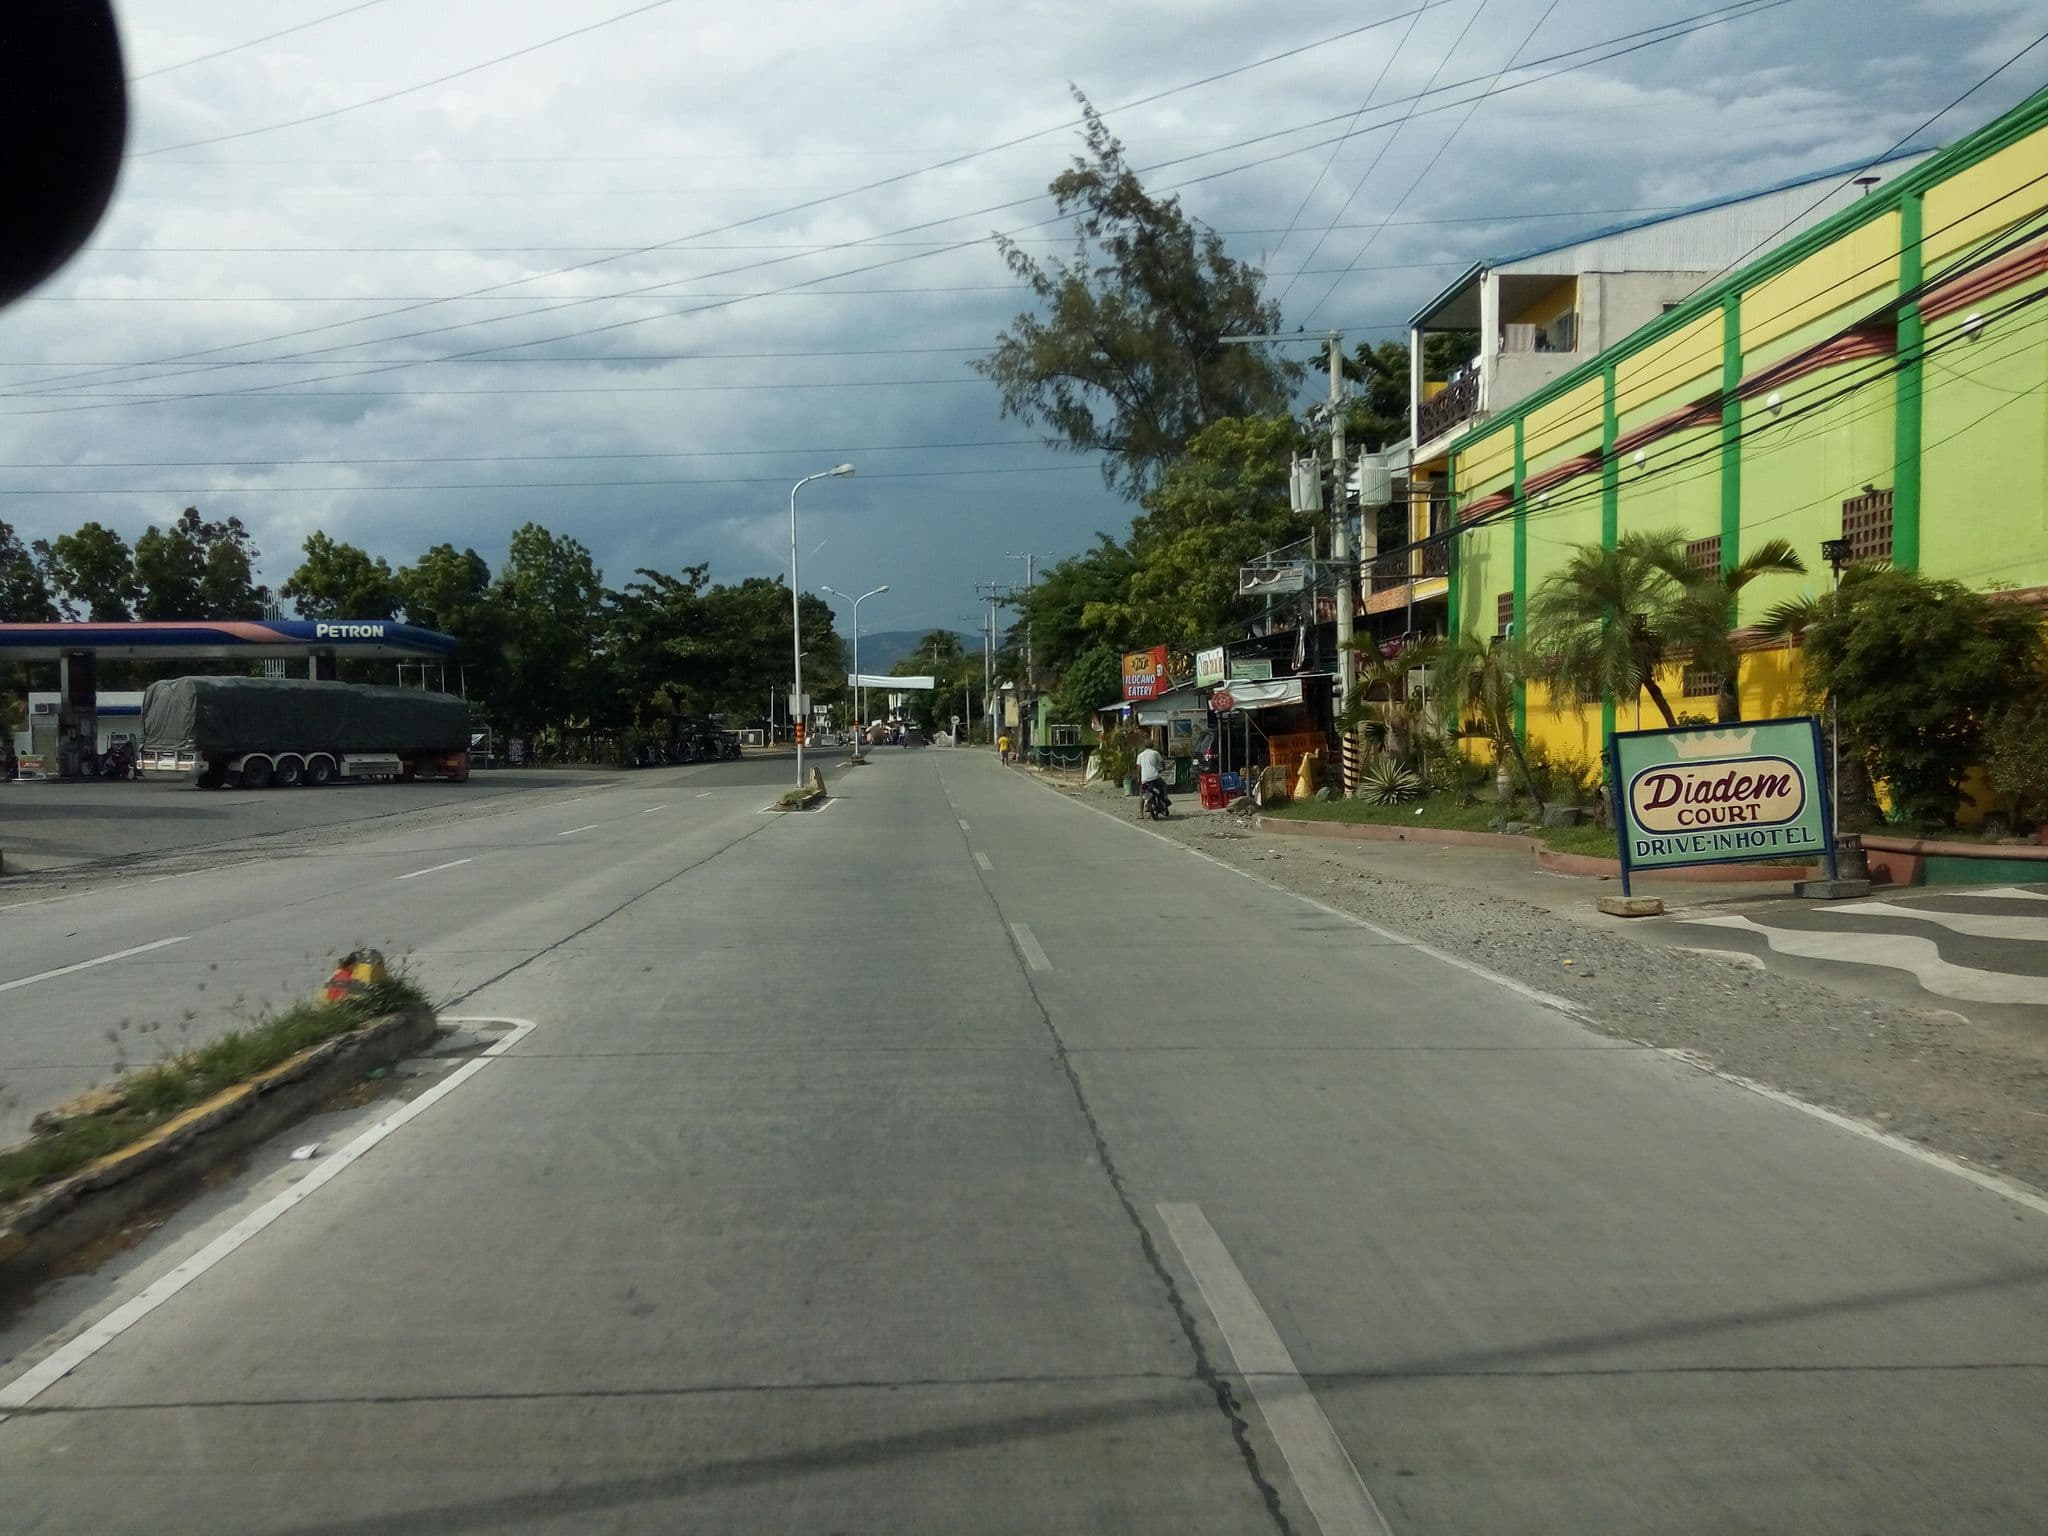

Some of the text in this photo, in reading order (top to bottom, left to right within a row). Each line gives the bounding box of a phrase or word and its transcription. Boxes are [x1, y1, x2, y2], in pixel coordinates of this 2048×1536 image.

[316, 623, 384, 638] PETRON
[1125, 675, 1156, 685] ILOCANO
[1128, 686, 1153, 697] EATERY
[1643, 770, 1792, 811] Diadem
[1677, 804, 1761, 825] COURT
[1635, 827, 1816, 857] DRIVE-IN HOTEL
